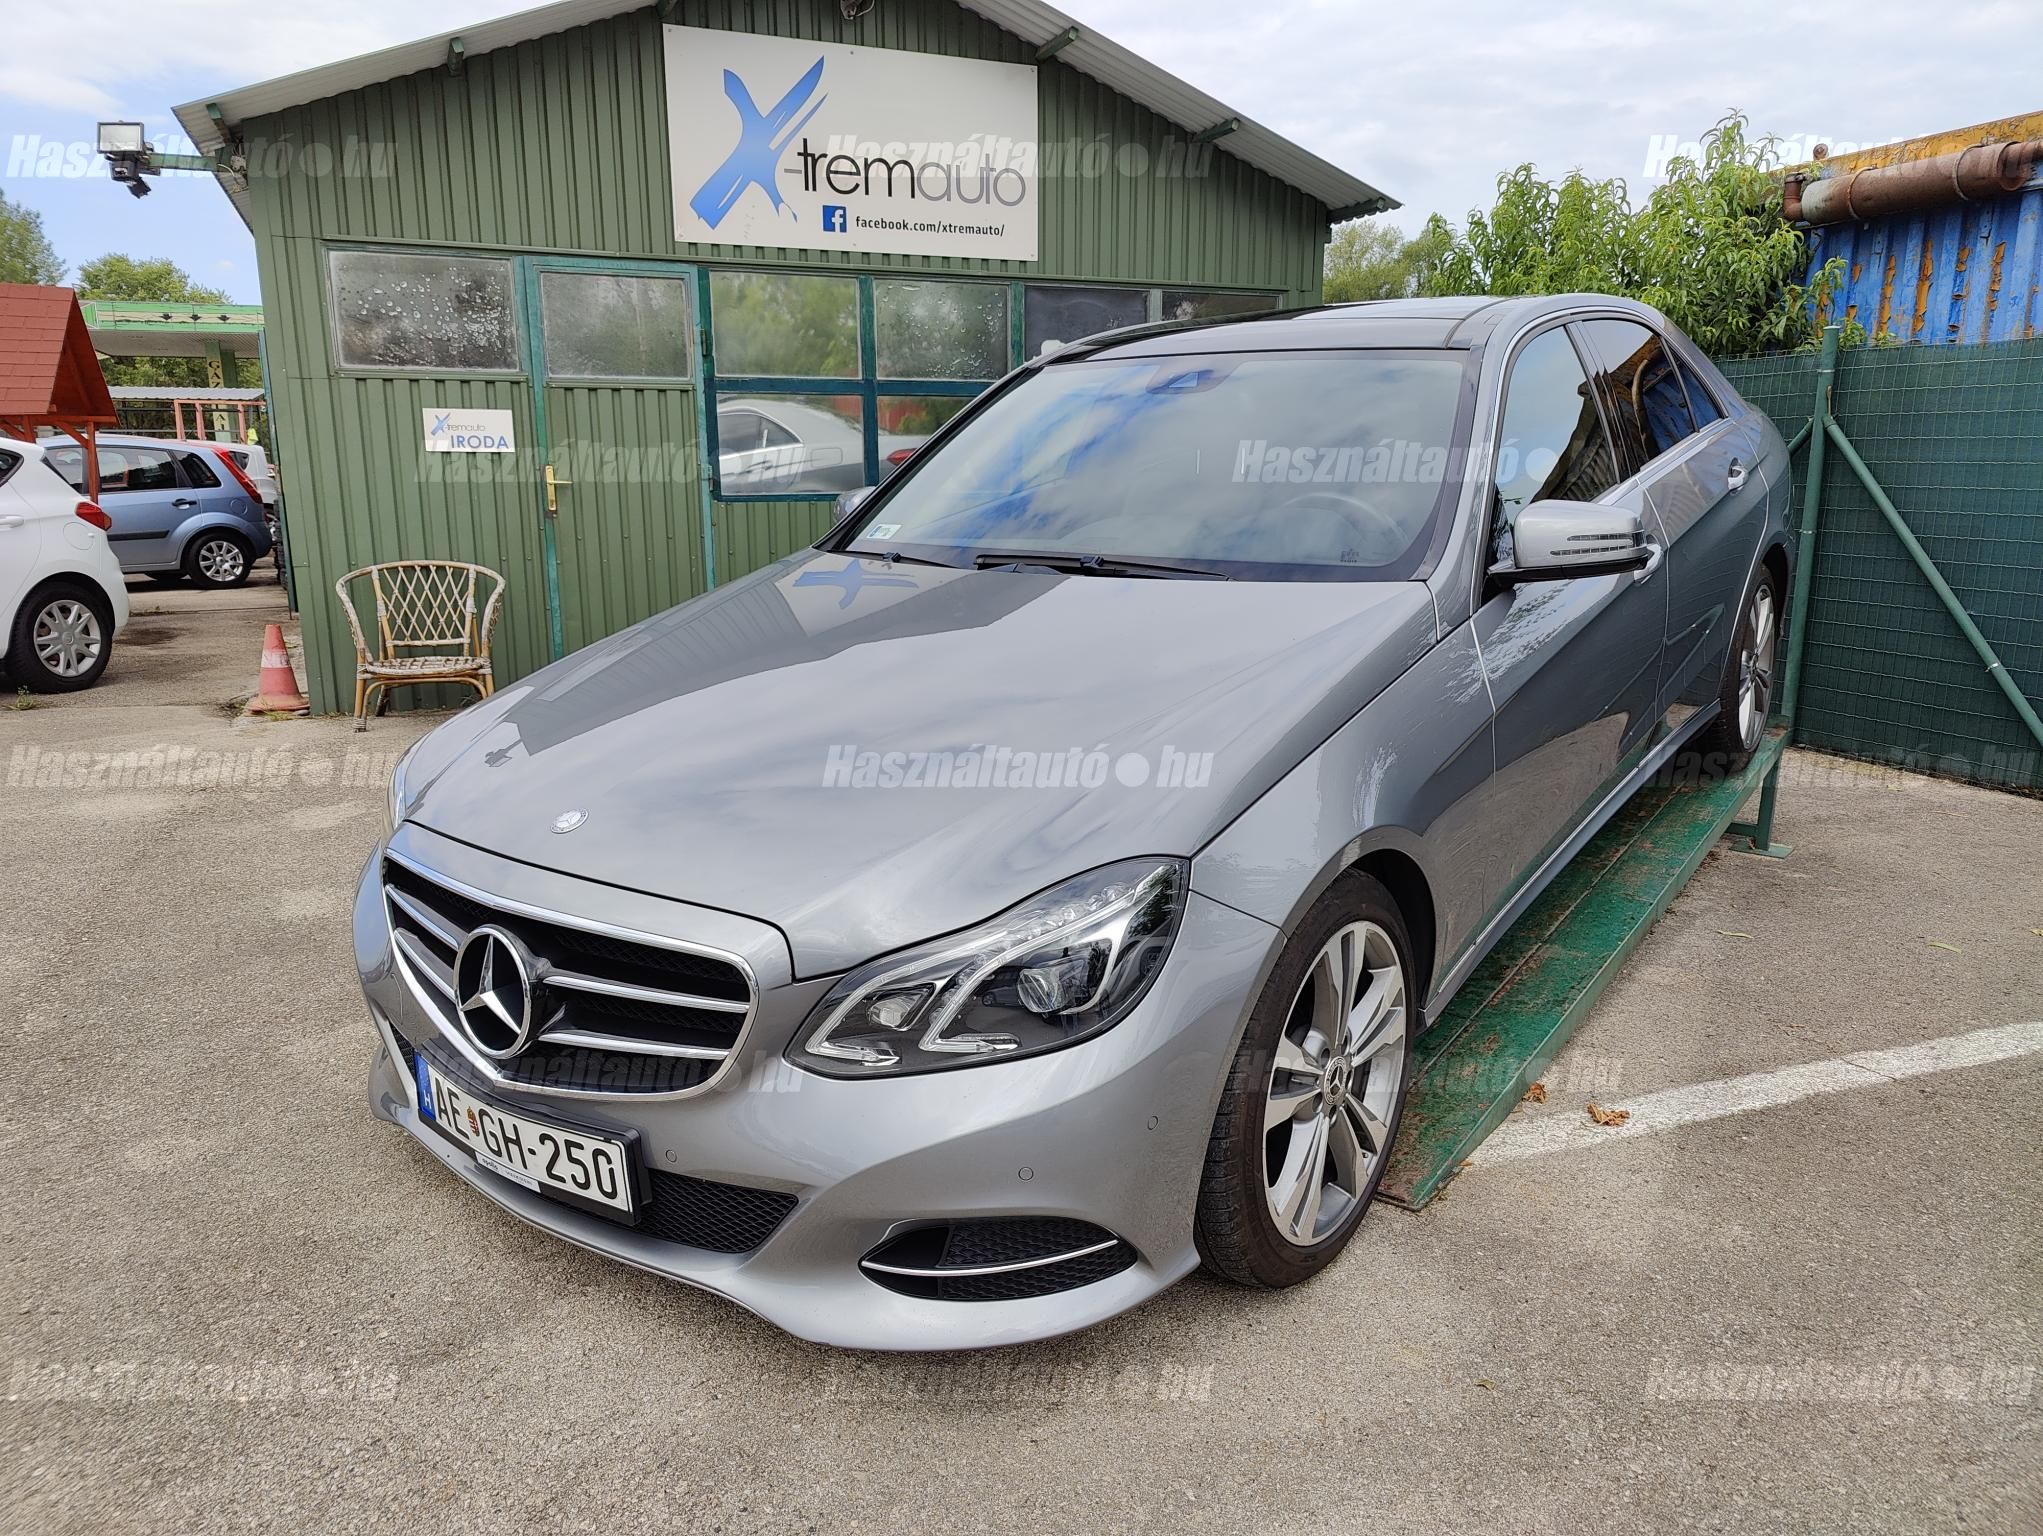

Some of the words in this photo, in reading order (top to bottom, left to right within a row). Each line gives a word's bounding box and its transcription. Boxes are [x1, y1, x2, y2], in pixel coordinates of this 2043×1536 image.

[855, 215, 1005, 237] facebook.com/xtremauto/
[450, 434, 509, 449] IRODA
[423, 1089, 432, 1109] H
[434, 1077, 470, 1140] AE
[478, 1108, 618, 1200] GH-250
